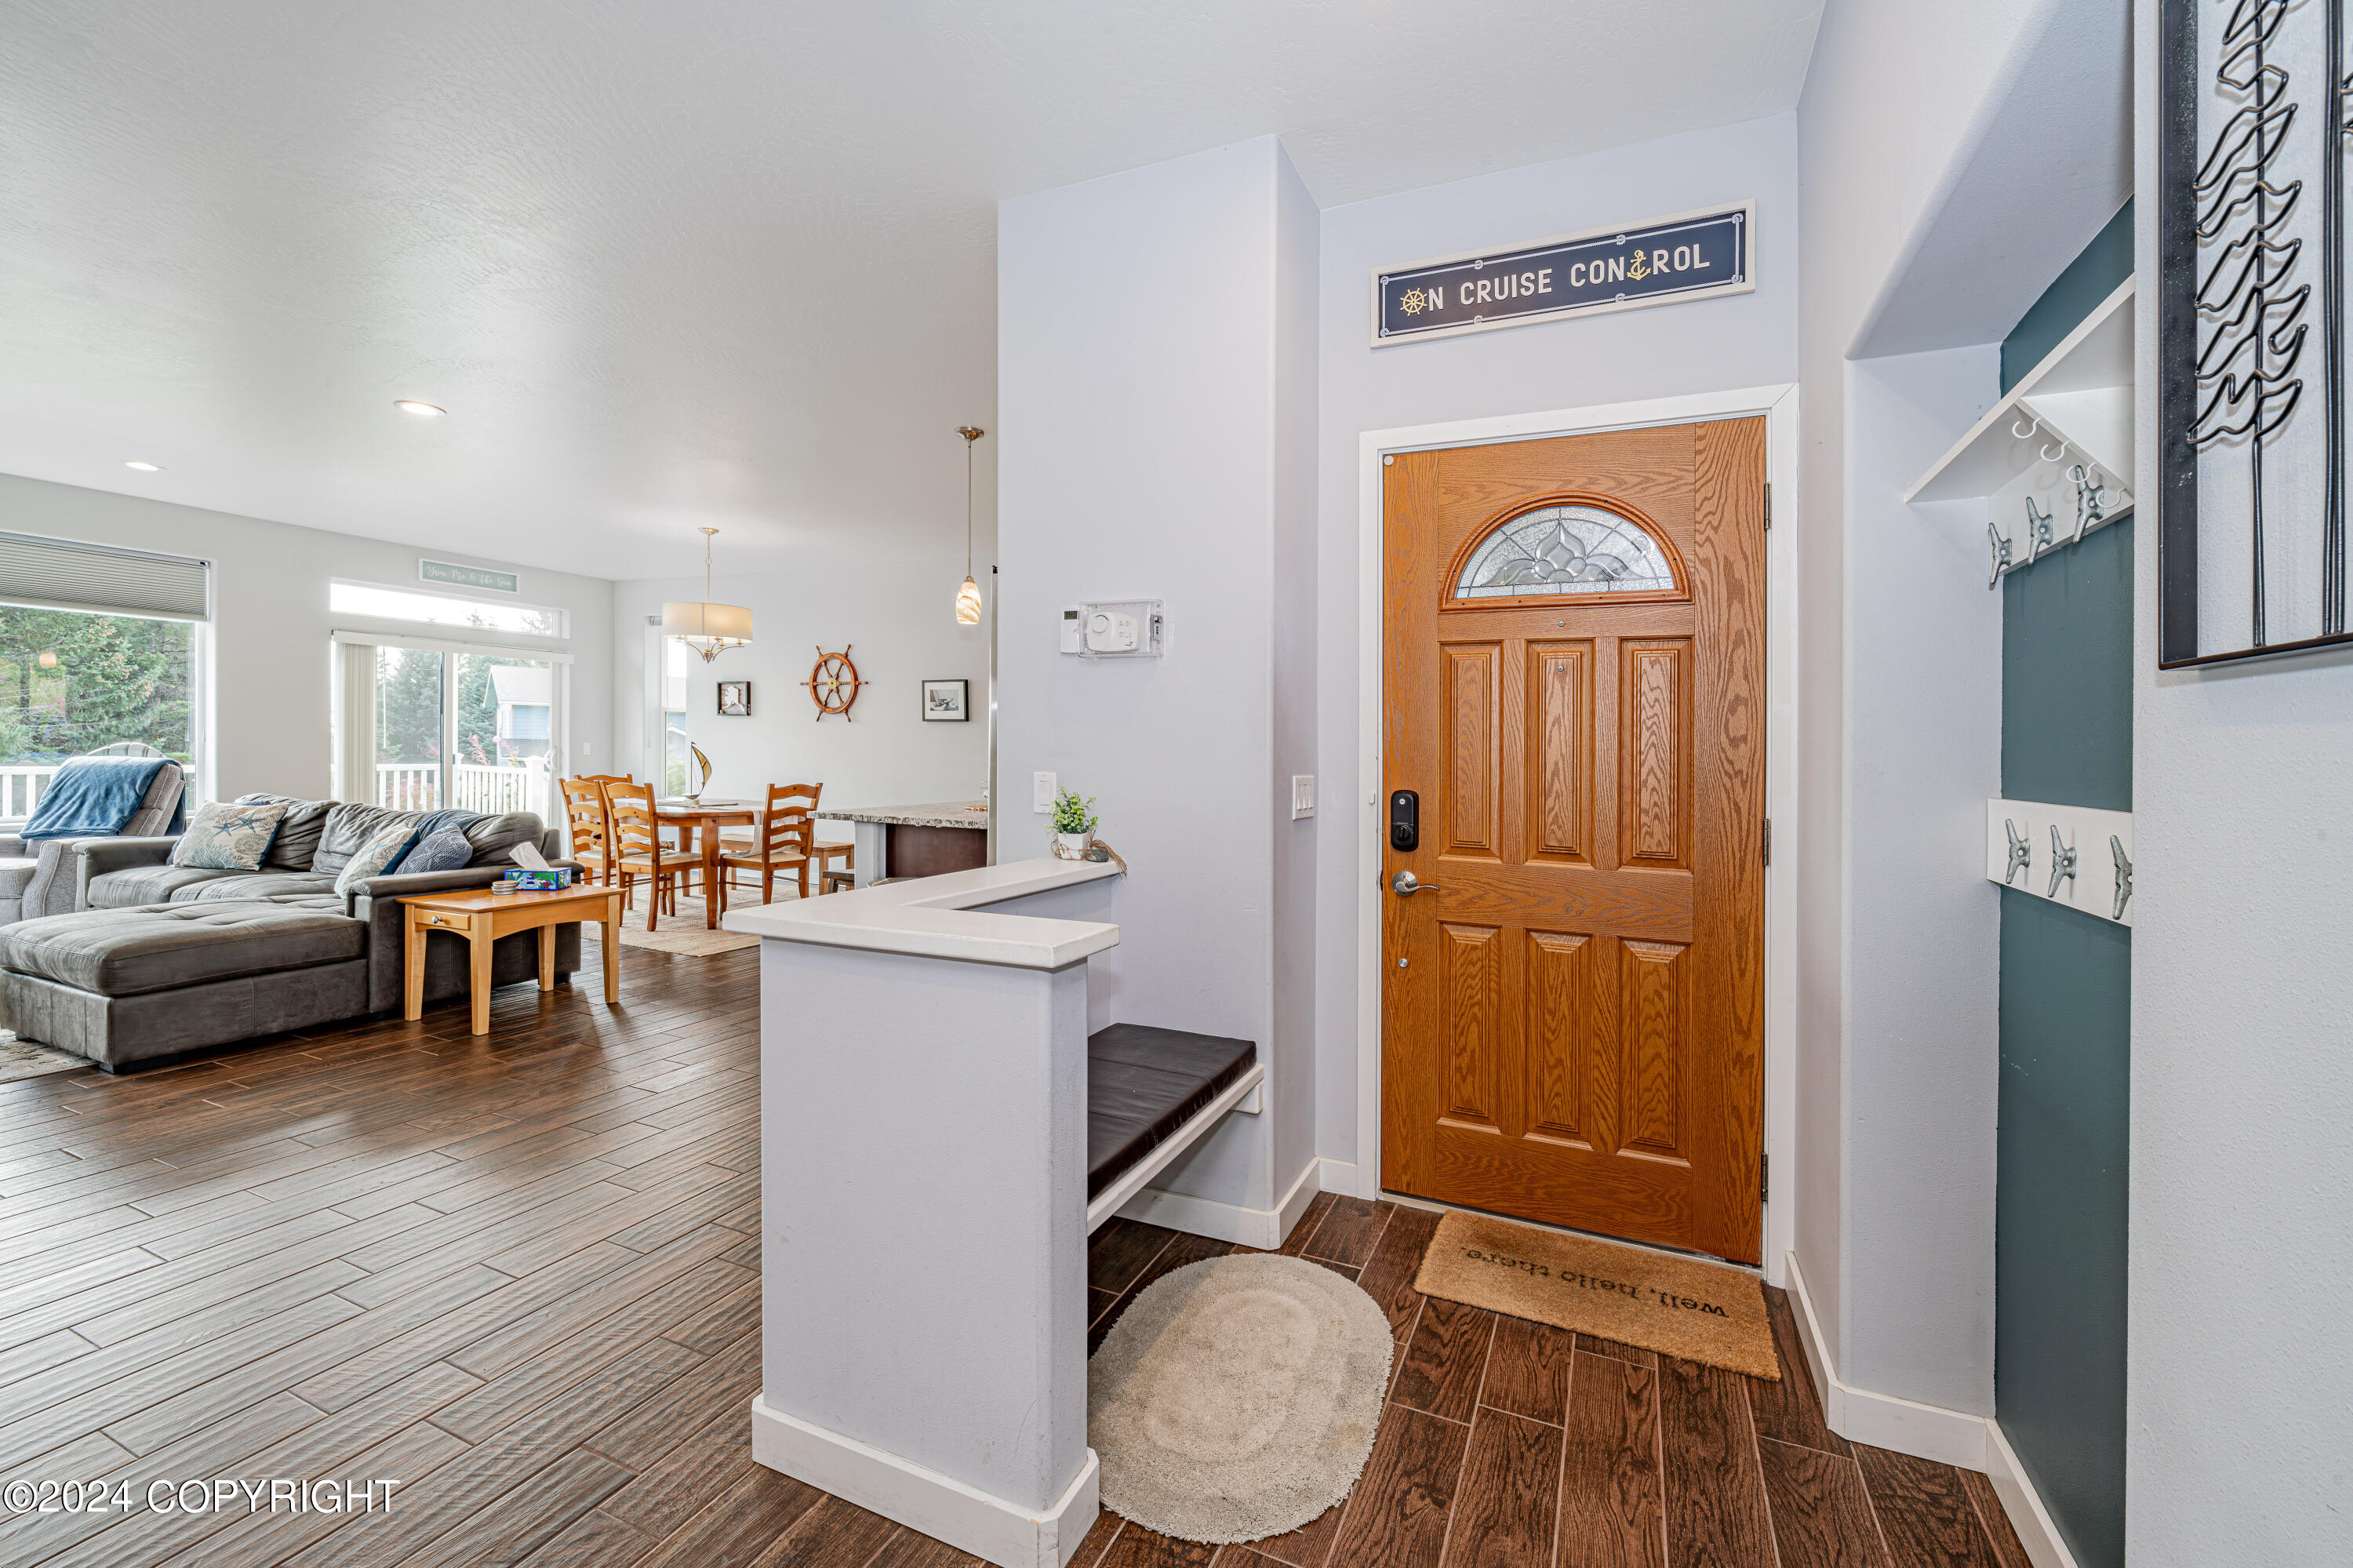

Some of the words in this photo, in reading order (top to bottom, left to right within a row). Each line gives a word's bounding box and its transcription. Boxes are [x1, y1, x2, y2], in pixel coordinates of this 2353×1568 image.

[1460, 268, 1553, 306] CRUISE
[425, 565, 447, 577] You
[449, 569, 465, 580] Me
[1560, 1270, 1640, 1301] hello
